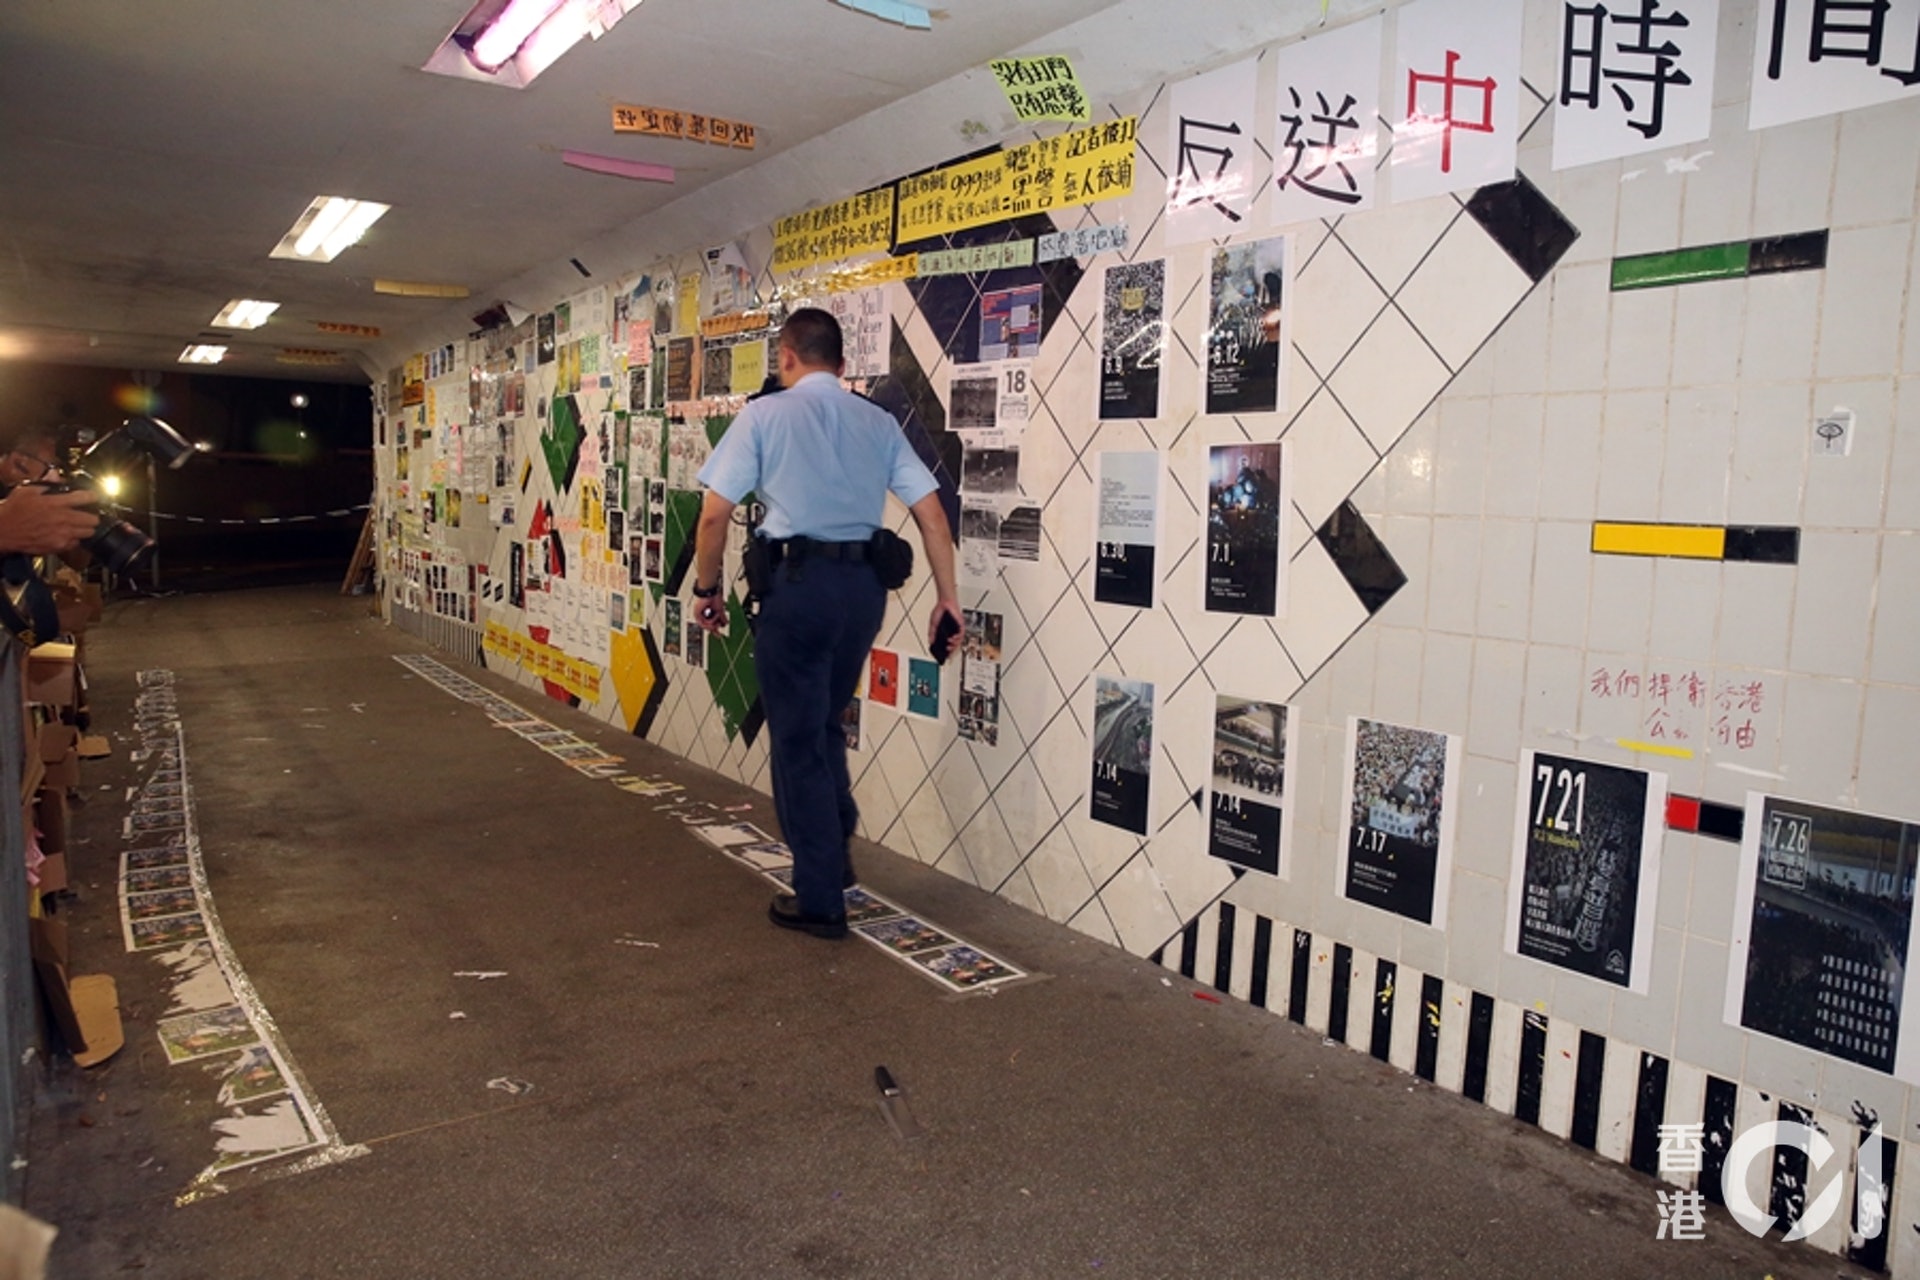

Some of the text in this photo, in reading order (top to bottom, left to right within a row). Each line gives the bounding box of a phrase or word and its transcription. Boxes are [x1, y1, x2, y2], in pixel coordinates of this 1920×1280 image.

[1006, 370, 1026, 393] 18
[1535, 765, 1586, 834] 7.21
[1356, 826, 1387, 854] 7.17
[1771, 817, 1807, 854] 7.26
